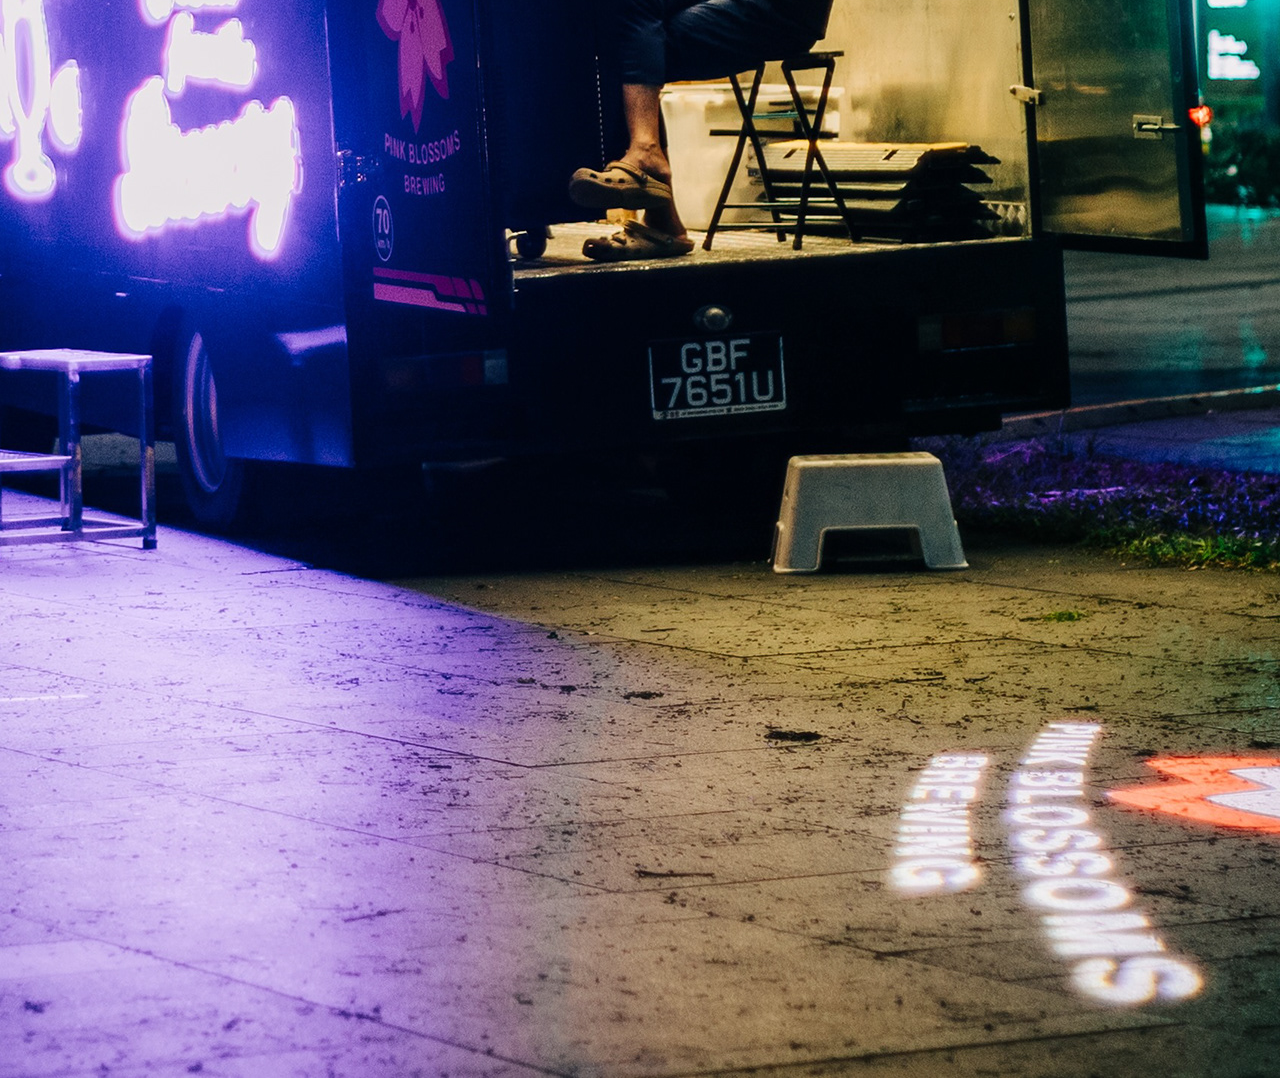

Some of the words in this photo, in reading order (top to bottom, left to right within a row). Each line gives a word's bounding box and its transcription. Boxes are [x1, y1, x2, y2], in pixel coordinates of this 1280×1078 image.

[384, 133, 406, 161] PINK
[408, 129, 460, 164] BLOSSOMS
[404, 173, 446, 195] BREWING
[376, 208, 390, 234] 70
[680, 338, 751, 373] GBF
[661, 369, 775, 409] 7651U
[1024, 721, 1103, 766] PINK
[888, 752, 990, 891] BREWING
[1011, 768, 1206, 1006] BLOSSOMS
